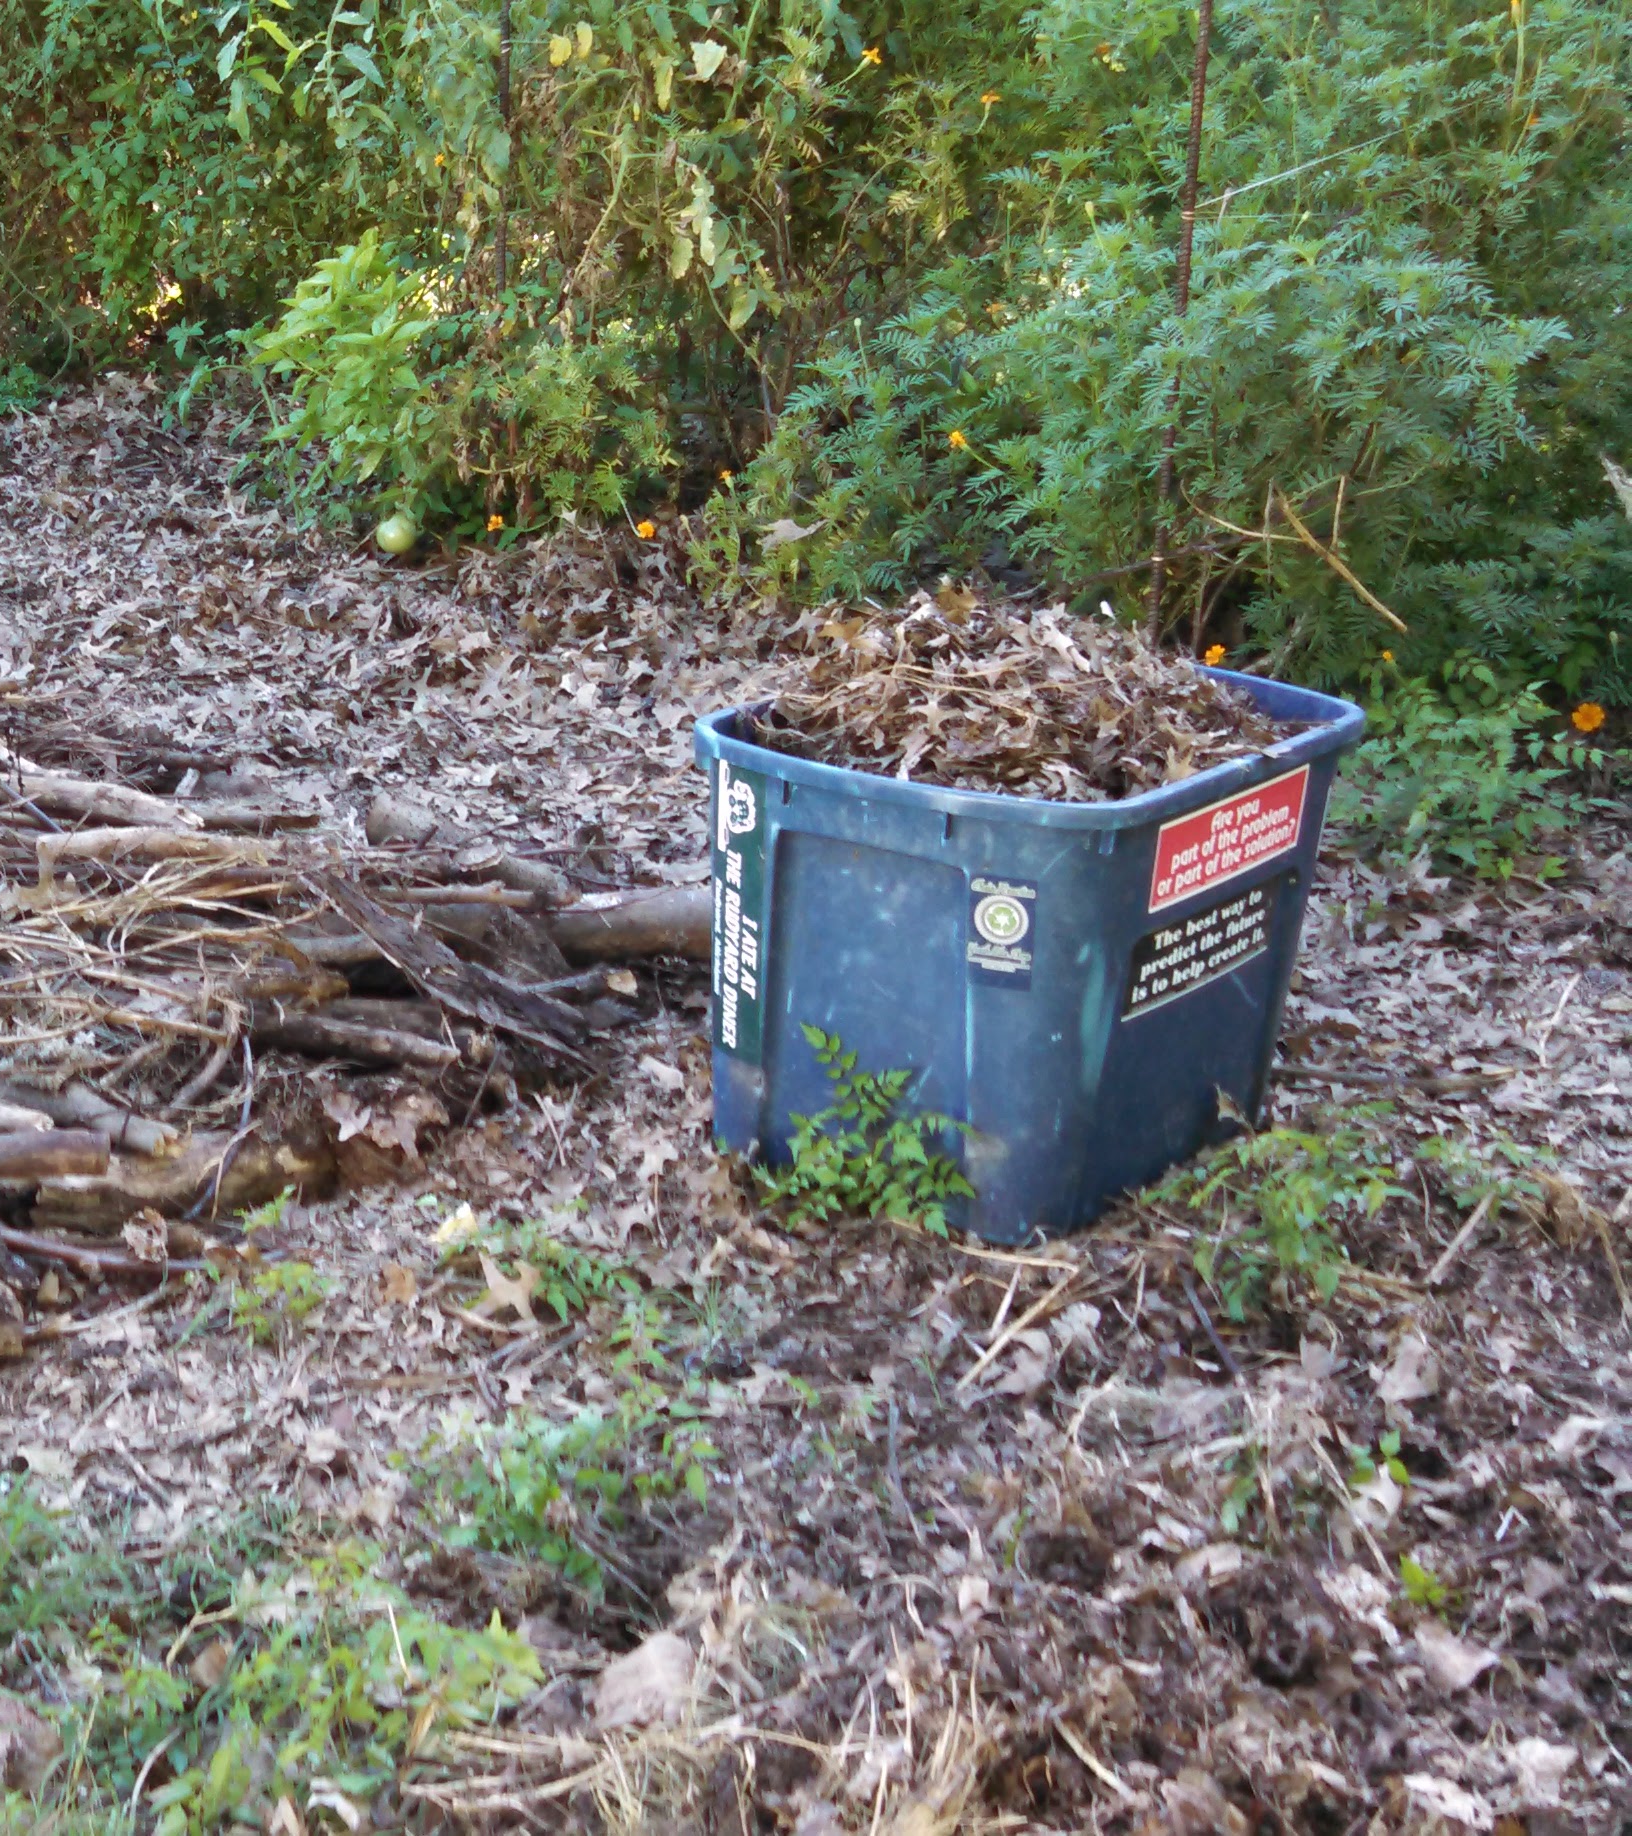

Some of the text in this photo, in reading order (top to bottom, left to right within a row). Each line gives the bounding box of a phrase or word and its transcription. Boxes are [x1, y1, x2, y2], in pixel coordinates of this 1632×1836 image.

[1171, 805, 1290, 875] part of the problem
[1211, 798, 1260, 833] Are you
[1157, 818, 1296, 896] or part of the solution?
[722, 849, 742, 1049] THE RUDYARD DINER
[740, 914, 758, 1000] I ATE AT
[1139, 909, 1266, 983] predict the future
[1154, 890, 1263, 950] The best way to
[1131, 926, 1265, 1004] is to help create it.
